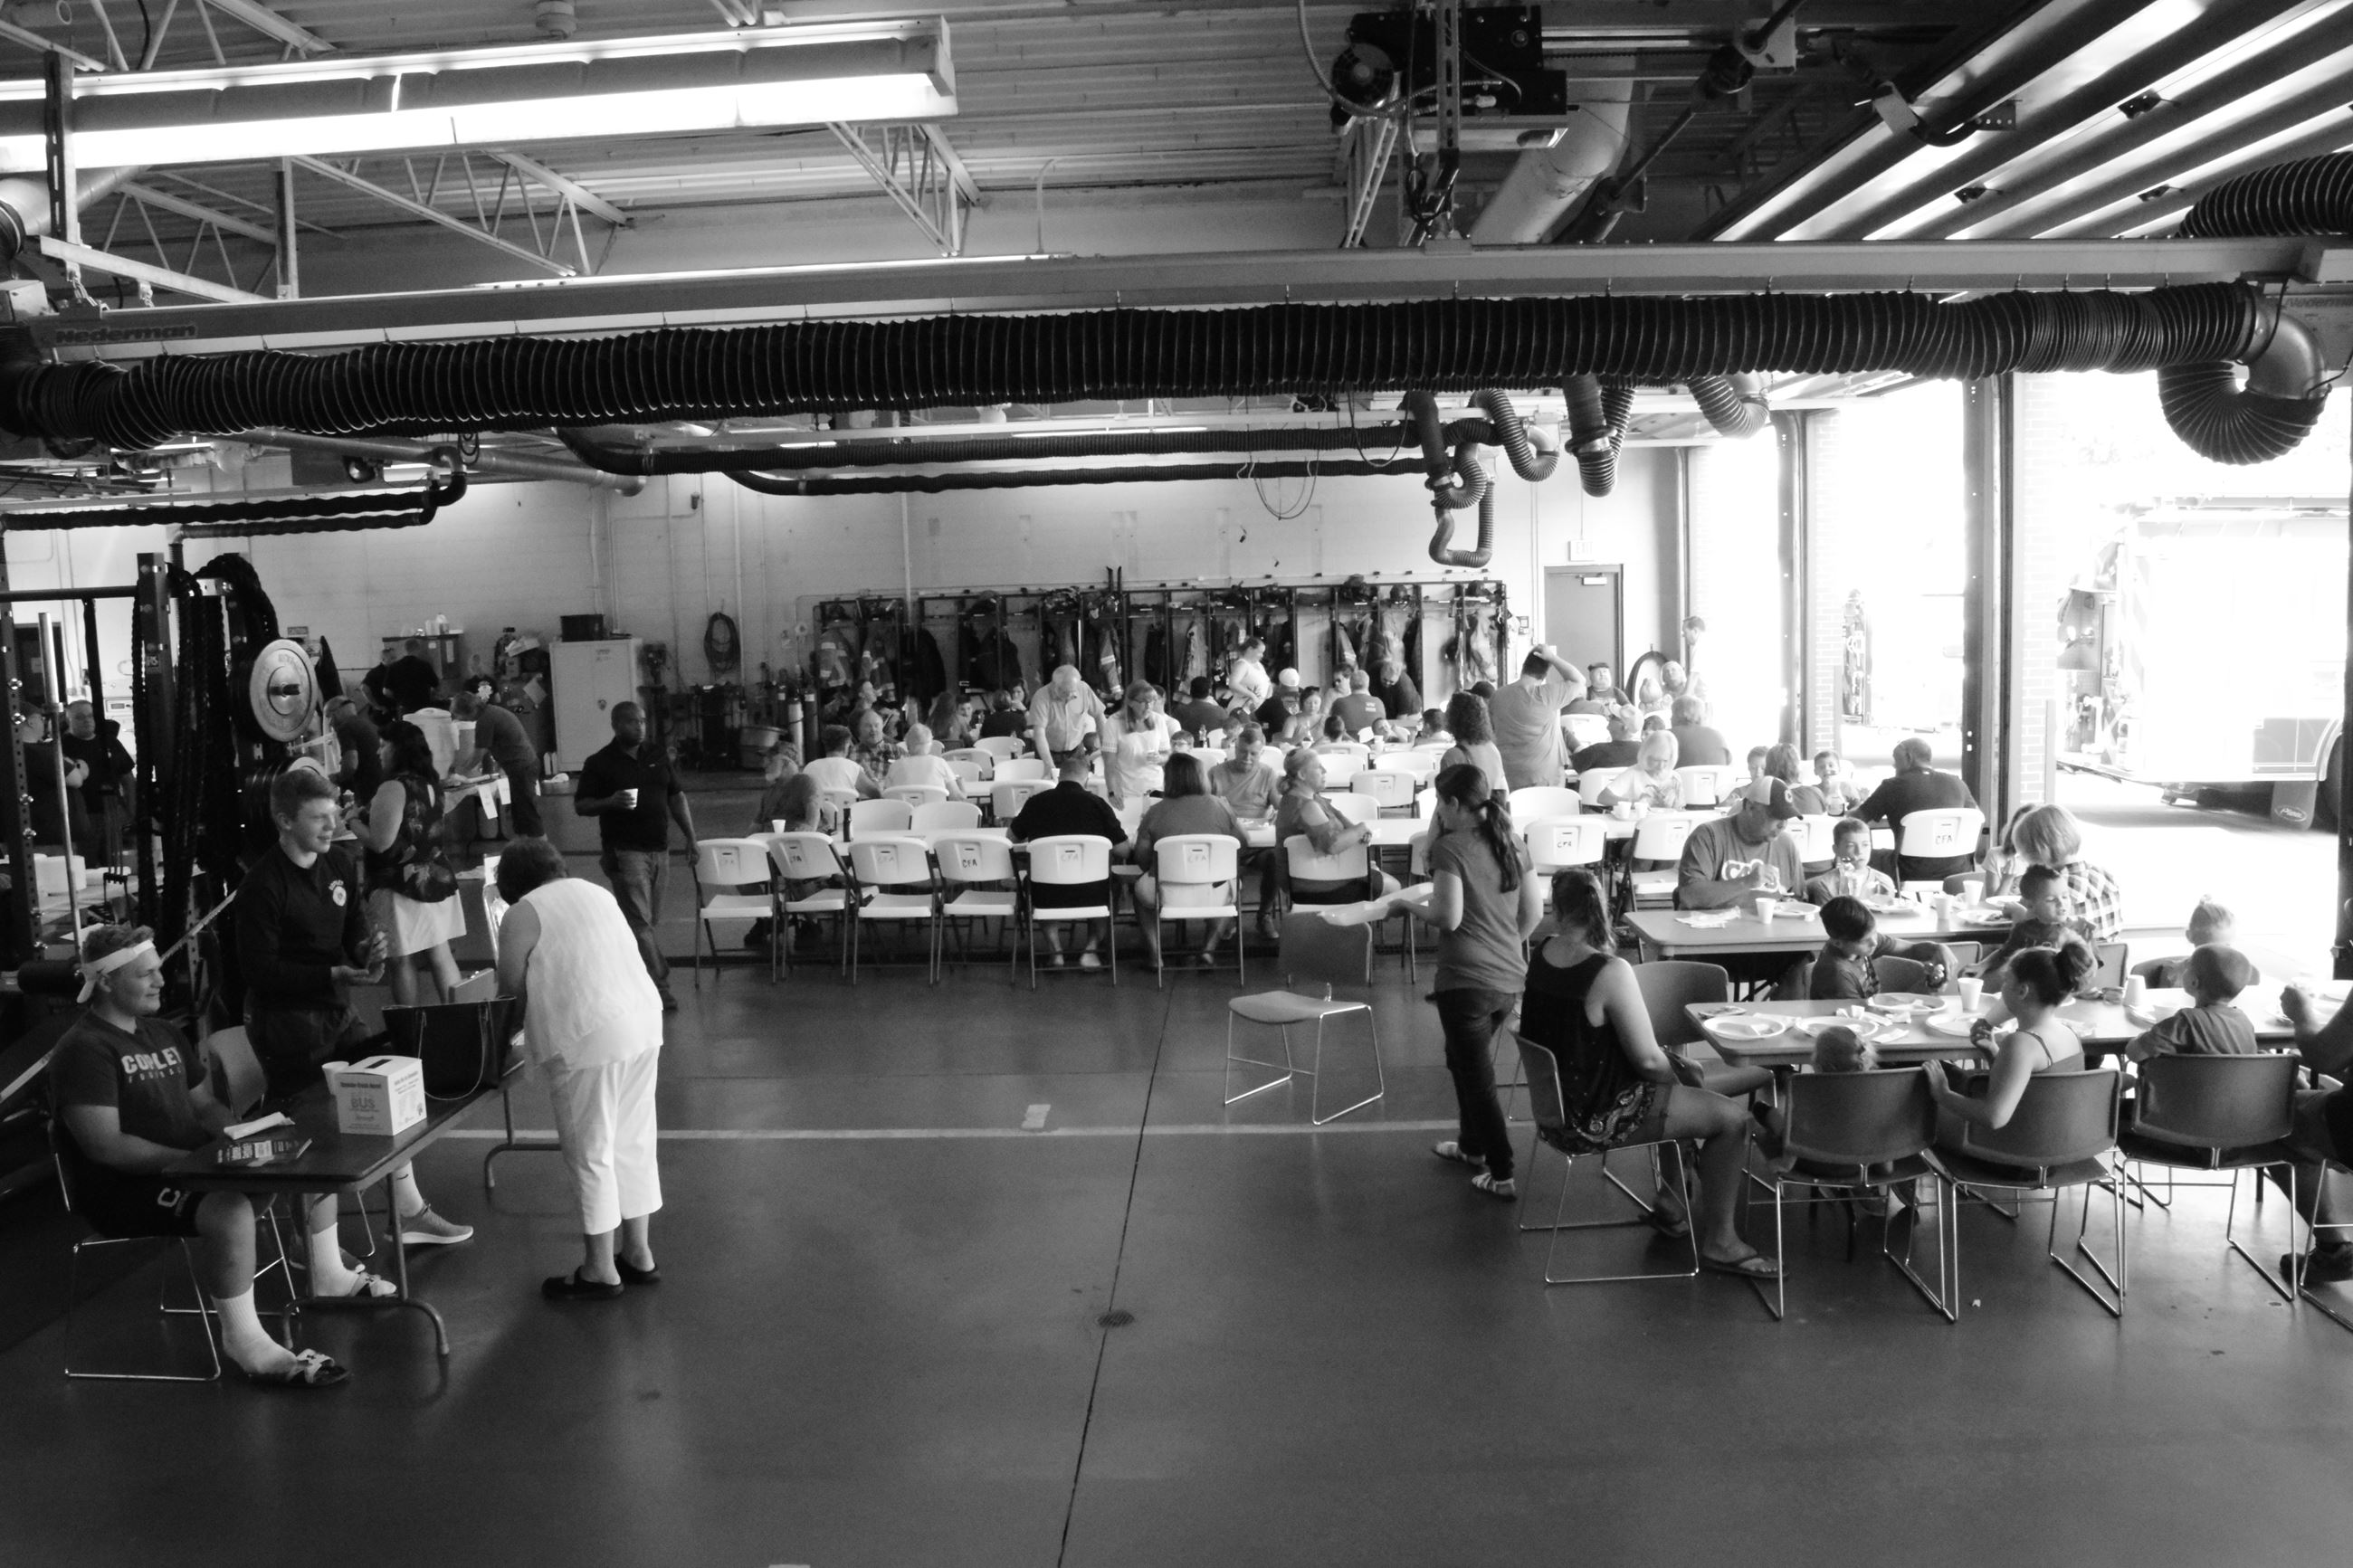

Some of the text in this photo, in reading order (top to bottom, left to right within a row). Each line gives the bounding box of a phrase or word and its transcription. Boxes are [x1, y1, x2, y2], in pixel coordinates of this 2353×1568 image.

[56, 325, 197, 344] Nederman
[1575, 541, 1593, 555] EXIT
[1935, 834, 1953, 845] CFA
[1061, 853, 1079, 862] CFA
[962, 859, 977, 869] CFA
